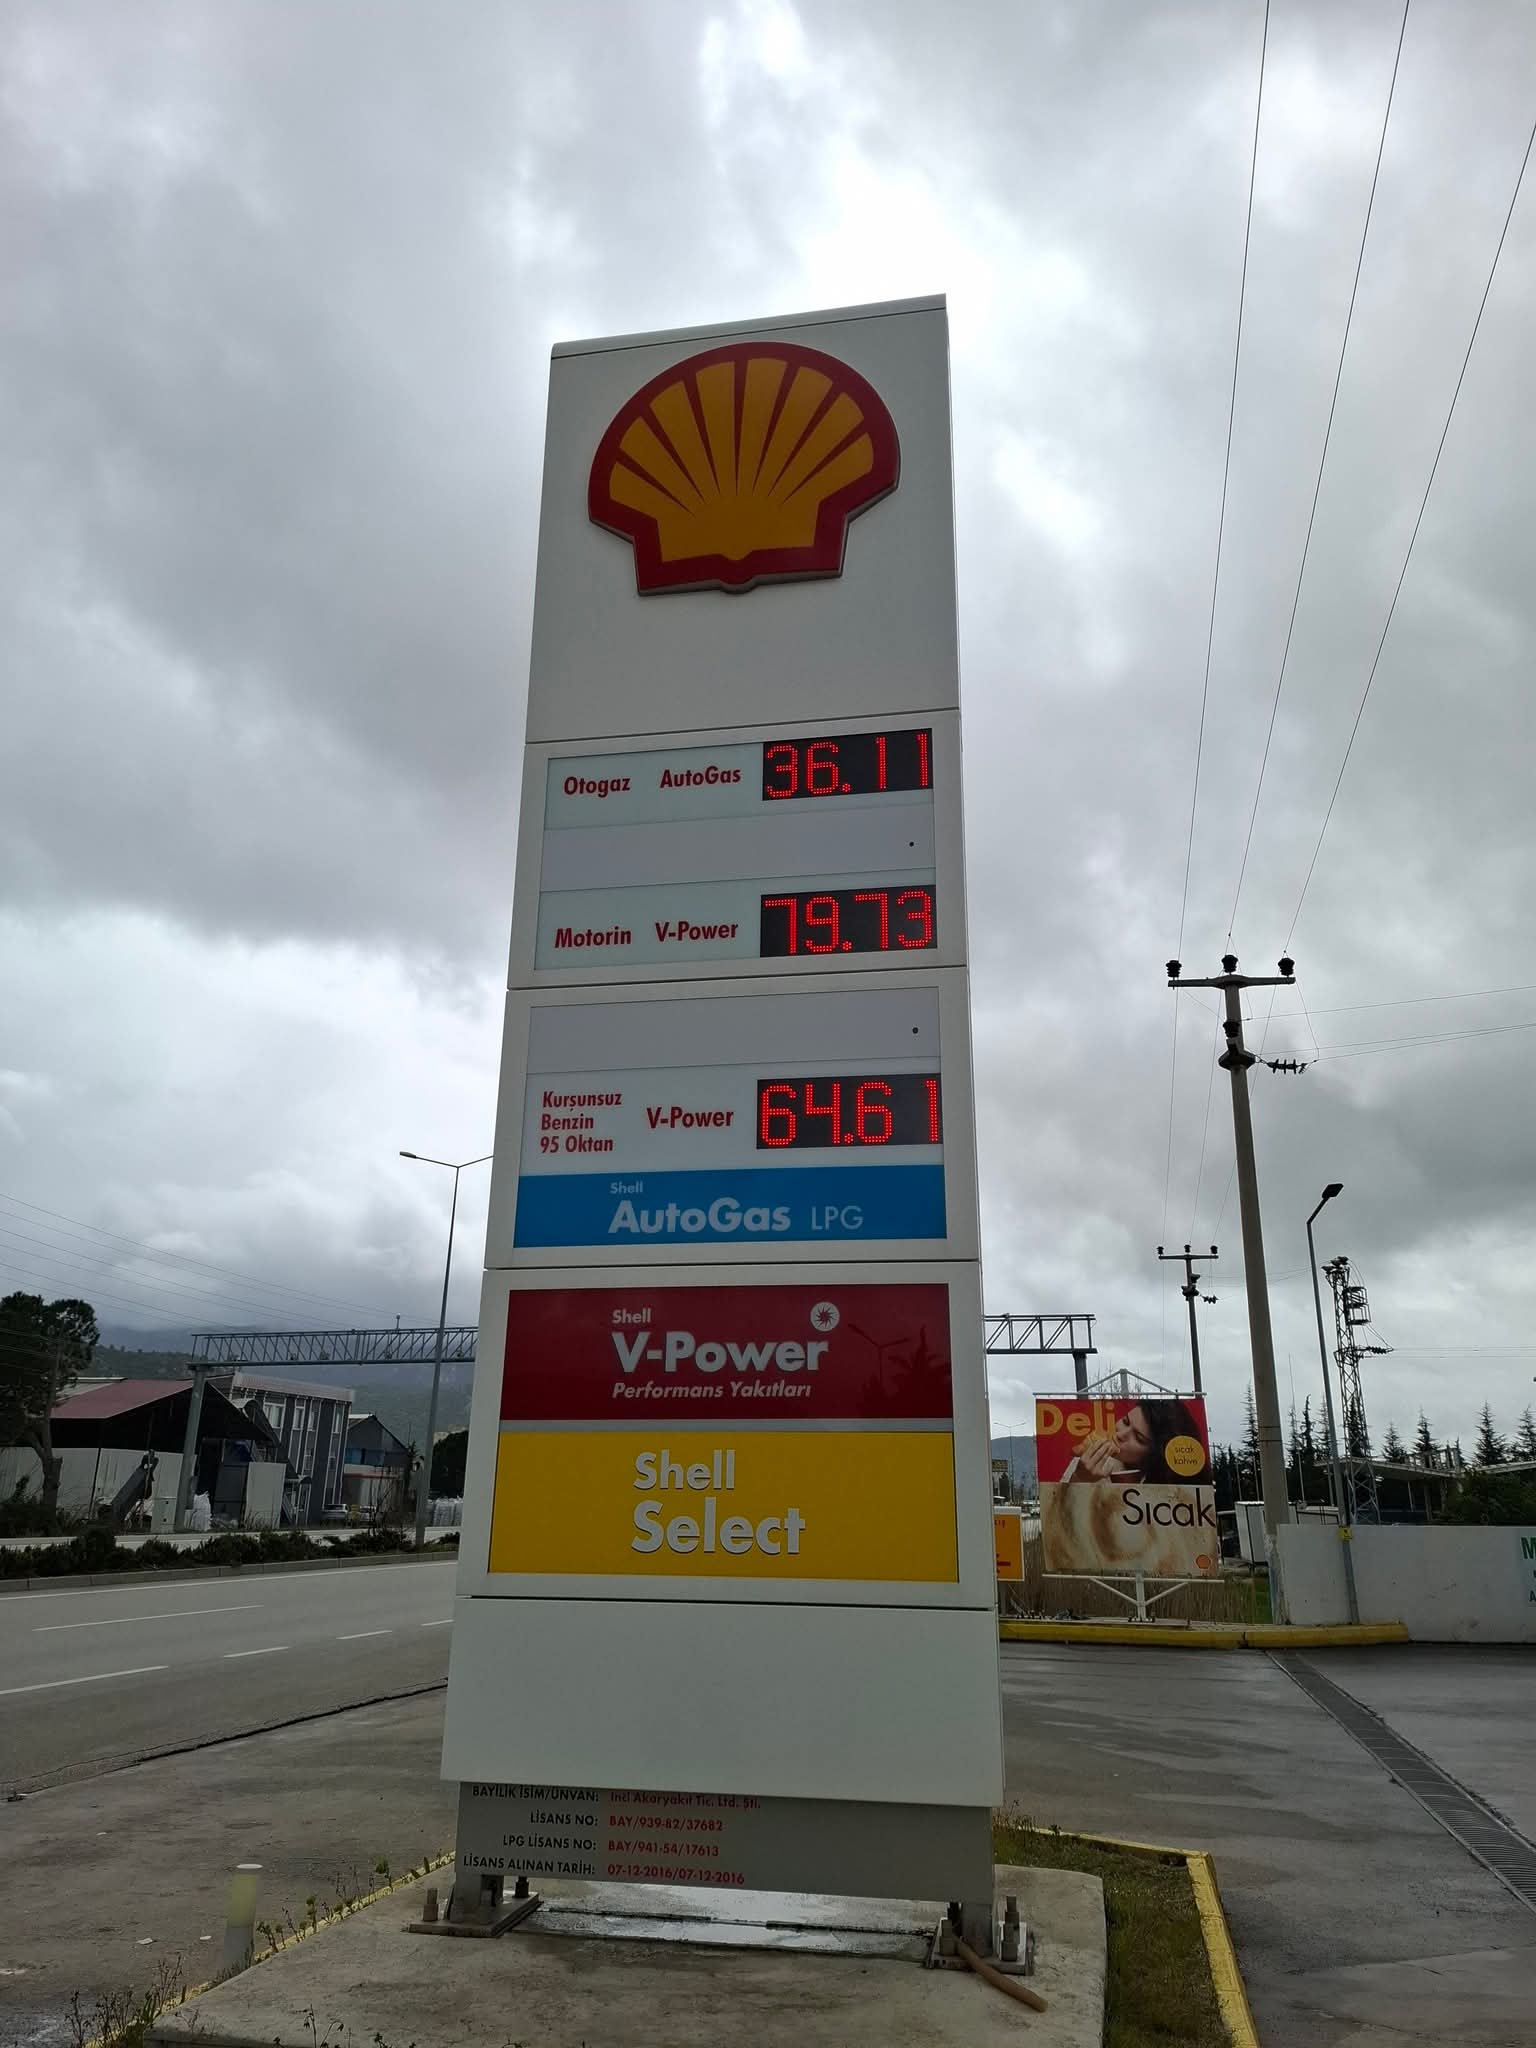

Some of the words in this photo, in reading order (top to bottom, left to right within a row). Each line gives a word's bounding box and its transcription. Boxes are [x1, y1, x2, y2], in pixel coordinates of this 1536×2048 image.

[766, 733, 929, 799] 36.11
[564, 776, 631, 798] Otogaz
[659, 765, 742, 789] AutoGas
[554, 926, 632, 949] Motorin
[655, 920, 738, 942] V-Power
[764, 890, 932, 955] 79.73
[542, 1091, 622, 1112] Kurşunsuz
[761, 1079, 939, 1146] 64.61
[541, 1113, 594, 1130] Benzin
[646, 1106, 734, 1129] V-Power
[540, 1137, 559, 1153] 95
[565, 1134, 614, 1153] Oktan
[610, 1181, 644, 1194] Shell
[607, 1197, 792, 1234] AutoGas
[811, 1205, 864, 1231] LPG
[612, 1308, 652, 1324] Shell
[611, 1331, 829, 1373] V-Power
[612, 1381, 724, 1399] Performans
[730, 1380, 811, 1398] Yakıtları
[1036, 1399, 1117, 1440] Deli
[633, 1449, 736, 1490] Shell
[631, 1496, 806, 1554] Select
[530, 1809, 571, 1825] LİSANS
[575, 1815, 598, 1826] NO:
[609, 1815, 723, 1831] BAY/939-82/37682
[503, 1835, 524, 1847] LPG
[528, 1833, 569, 1849] LİSANS
[573, 1839, 597, 1850] NO:
[608, 1840, 719, 1857] BAY/941-54/17613
[463, 1853, 505, 1869] LİSANS
[508, 1859, 554, 1872] ALINAN
[557, 1860, 596, 1875] TARİH:
[607, 1863, 745, 1885] 07-12-2016/07-12-2016
